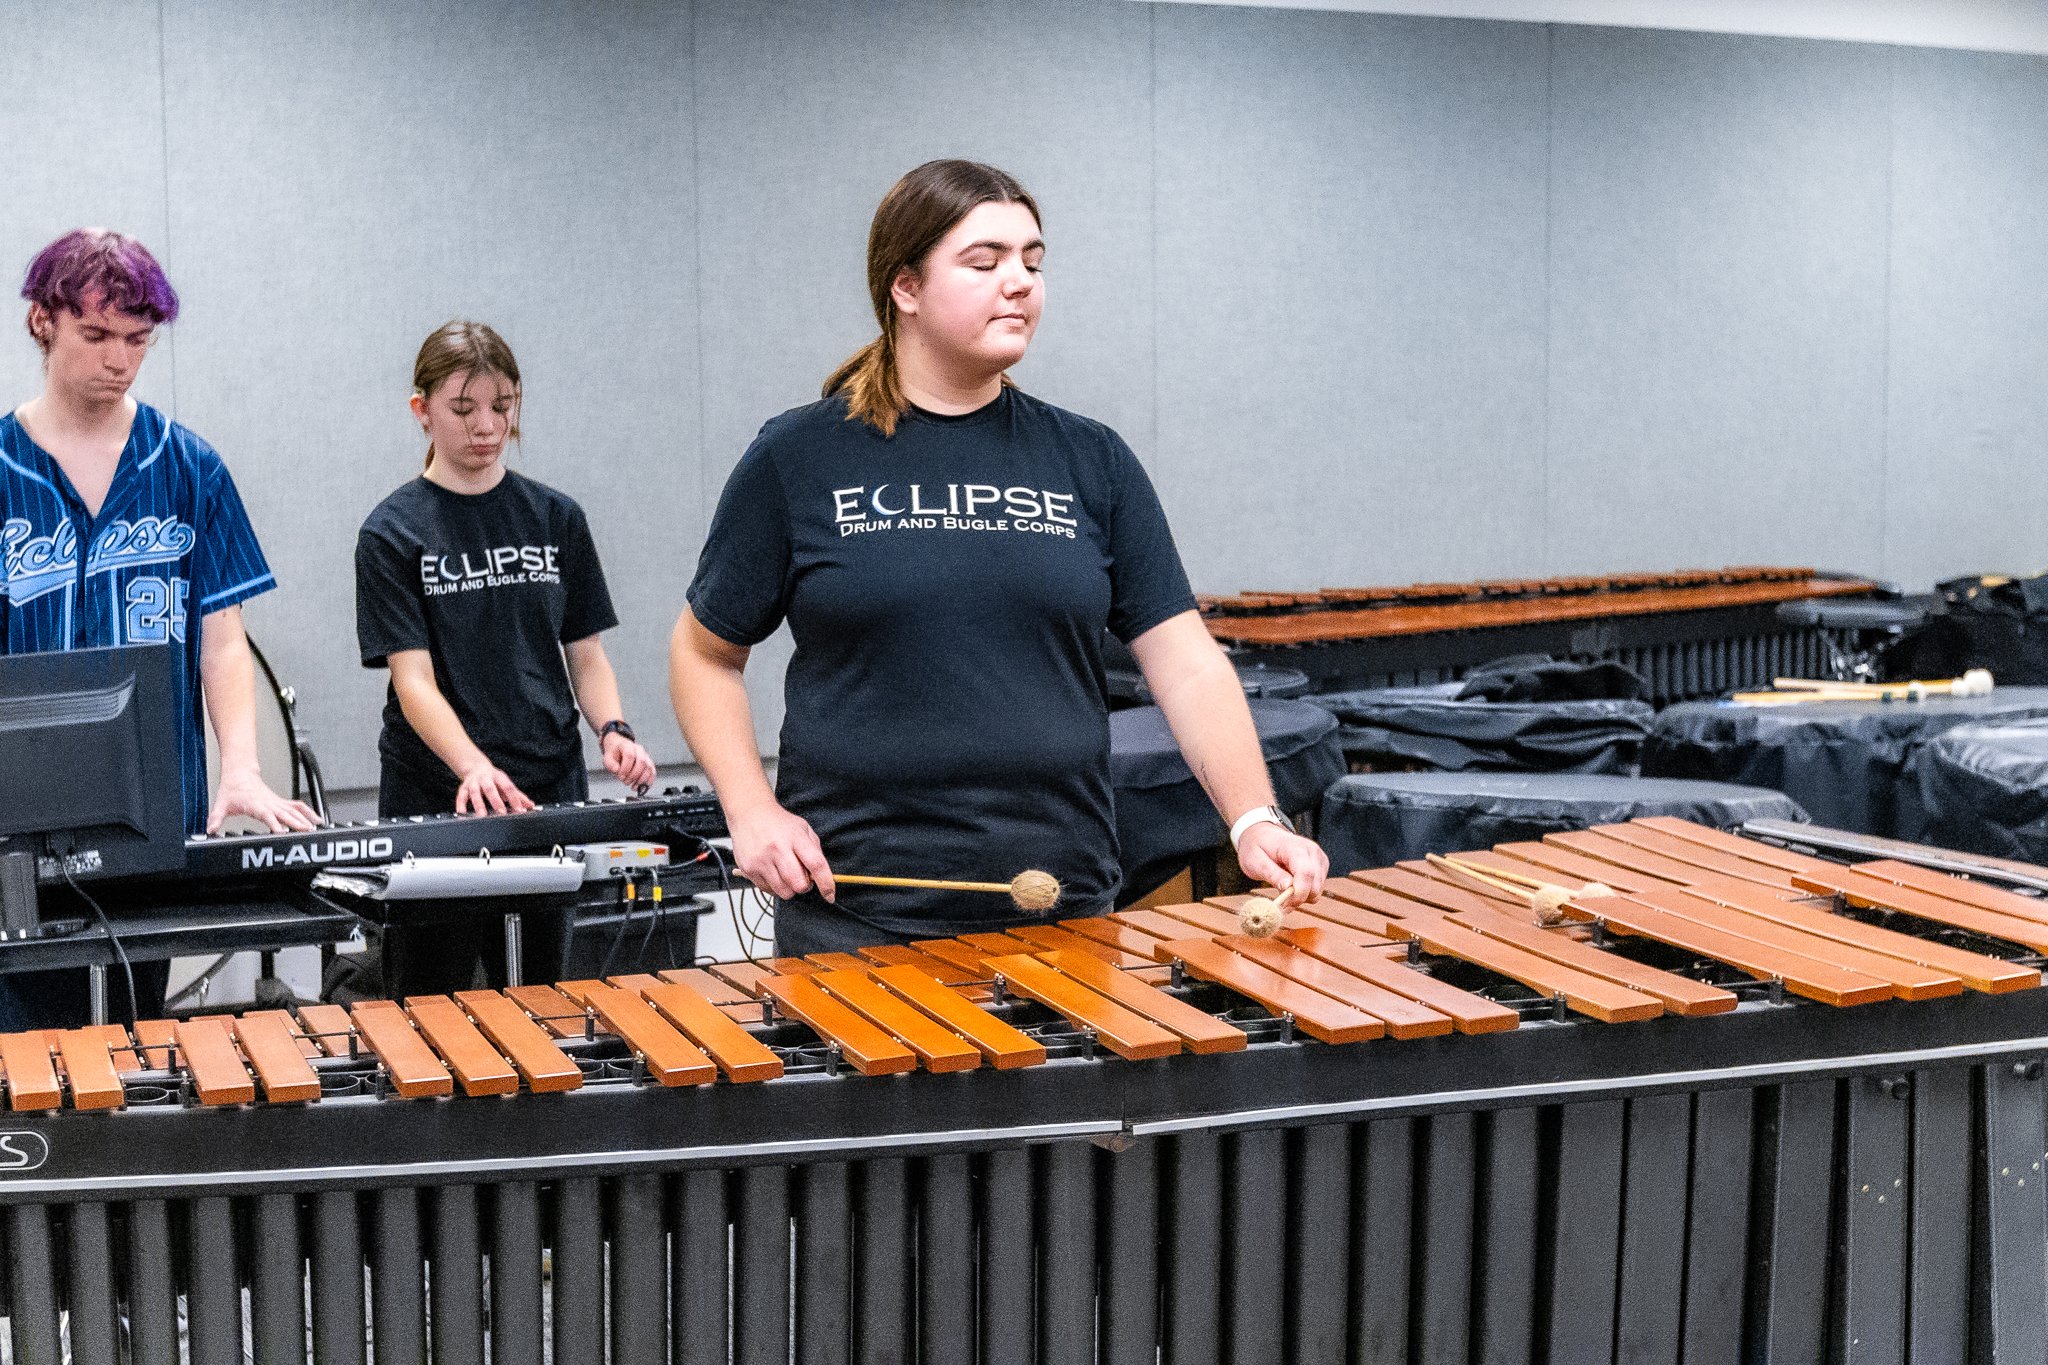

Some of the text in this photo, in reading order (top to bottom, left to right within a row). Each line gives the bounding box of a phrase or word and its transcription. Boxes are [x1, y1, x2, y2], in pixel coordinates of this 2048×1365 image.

[832, 484, 1077, 527] ECLIPSE
[840, 517, 1077, 539] DRUM AND BUGLE CORPS
[0, 515, 196, 584] Eclpse
[421, 545, 560, 583] ECLIPSE
[424, 583, 458, 596] DRUM
[461, 580, 485, 592] AND
[242, 837, 393, 869] M-AUDIO
